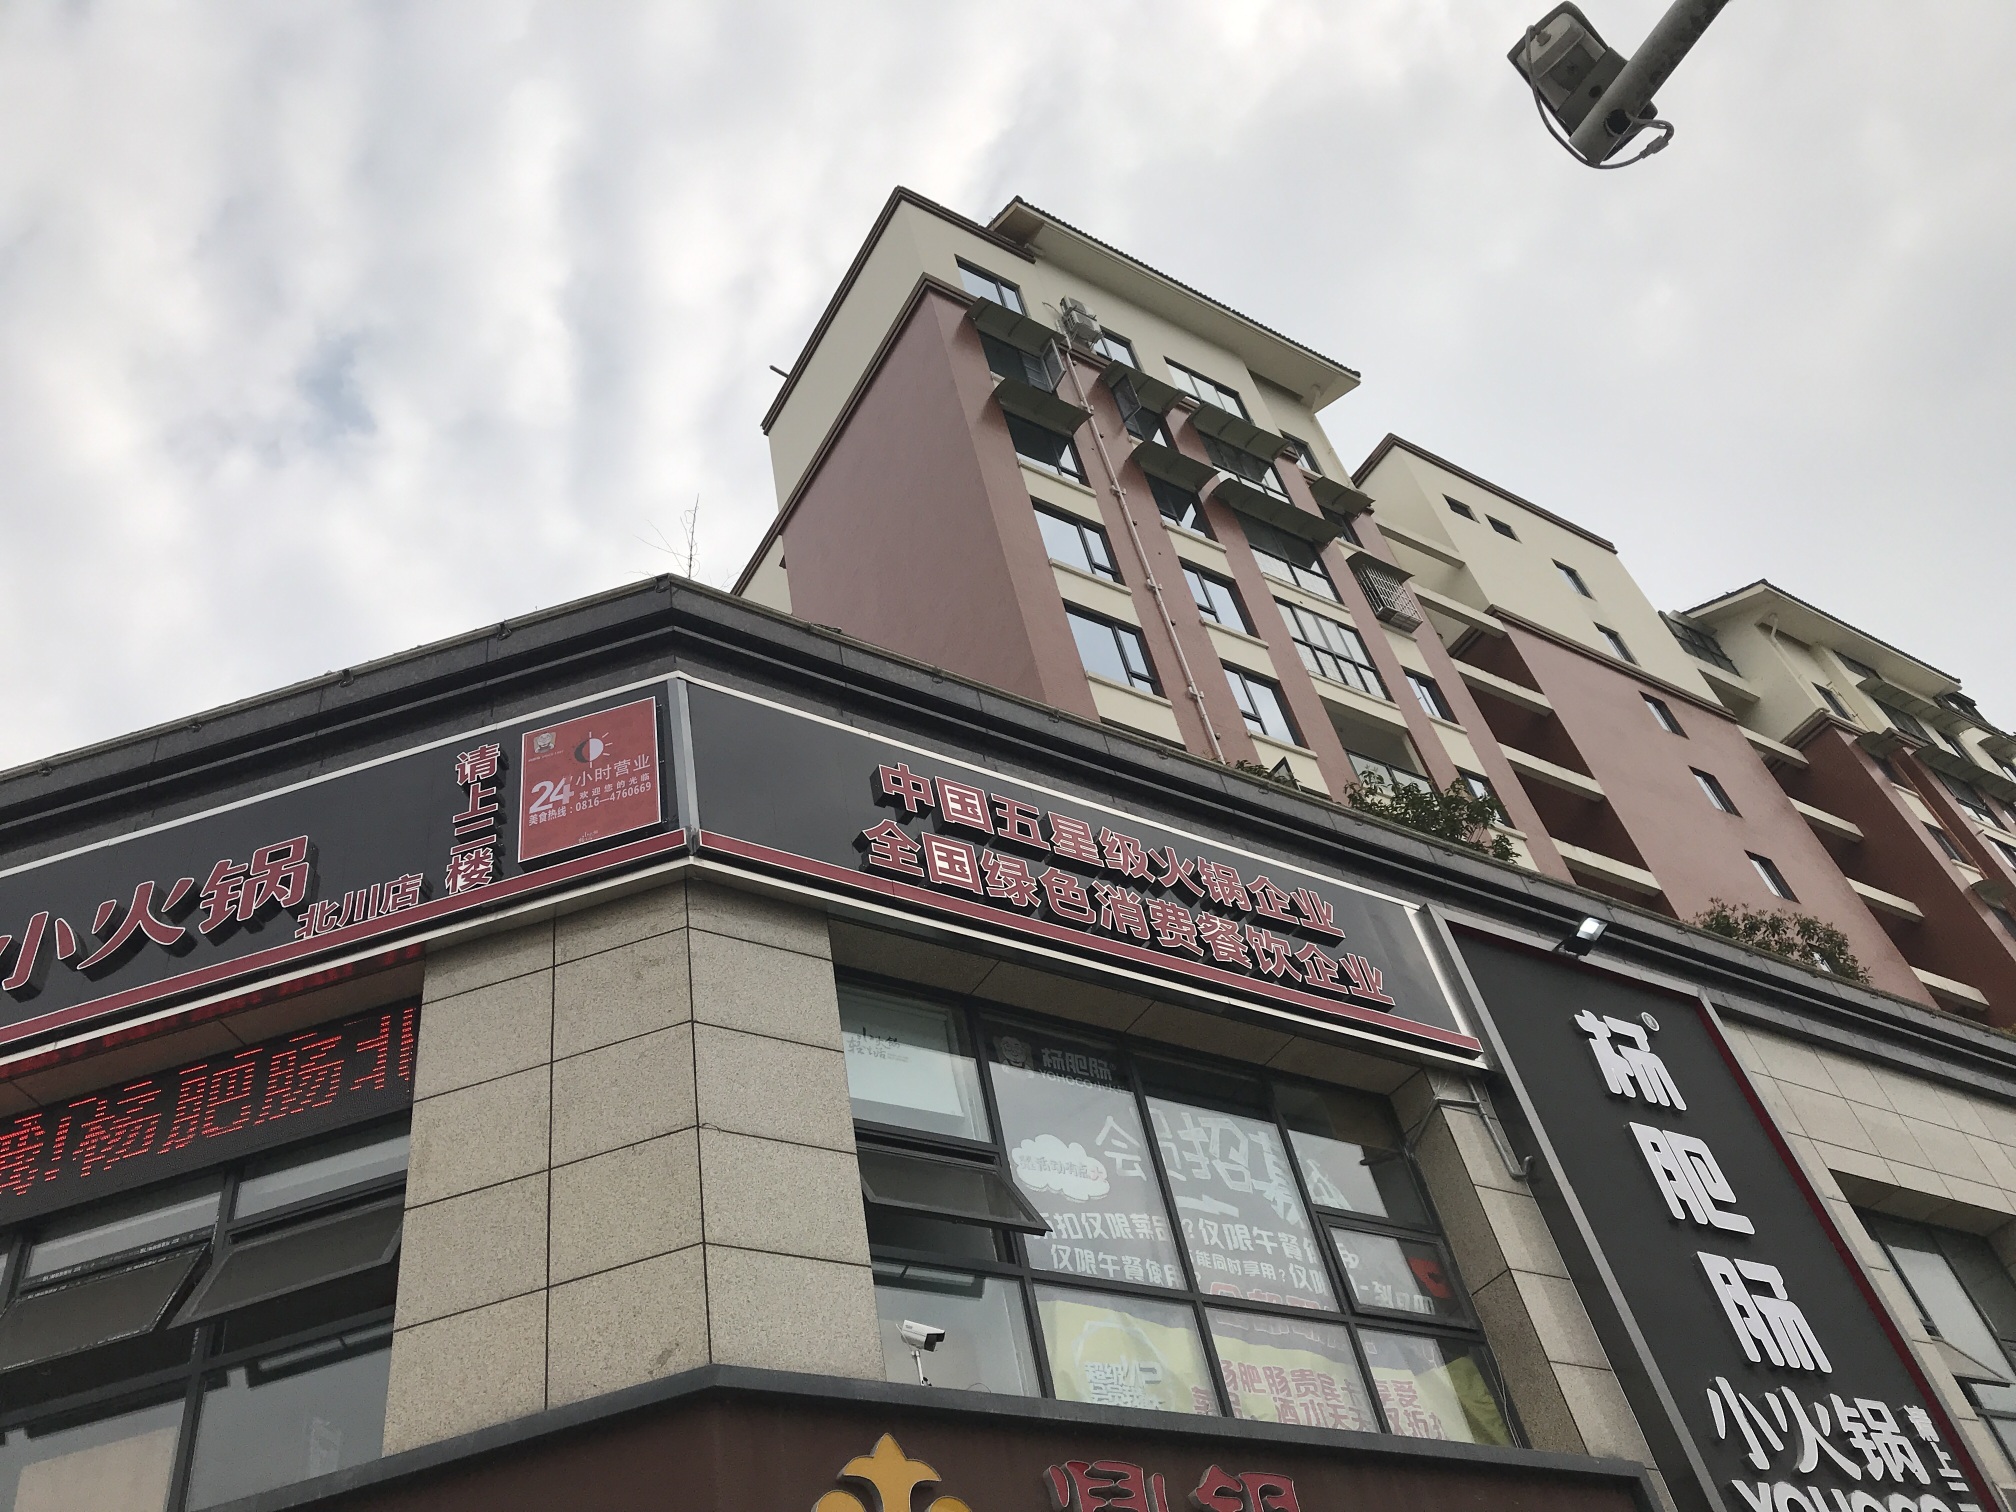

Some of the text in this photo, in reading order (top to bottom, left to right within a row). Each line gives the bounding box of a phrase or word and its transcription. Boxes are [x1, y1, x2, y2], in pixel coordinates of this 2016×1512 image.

[445, 743, 500, 895] 请上二楼
[529, 753, 650, 814] 24 小时营业
[579, 773, 650, 800] 欢迎您的光临
[879, 762, 1346, 939] 中国五星级火锅企业
[0, 835, 309, 990] 小火锅
[295, 872, 424, 940] 北川店
[863, 819, 1396, 1006] 全国绿色消费餐饮企业
[1574, 1009, 1833, 1374] 杨肥肠
[1706, 1376, 1931, 1485] 小火锅
